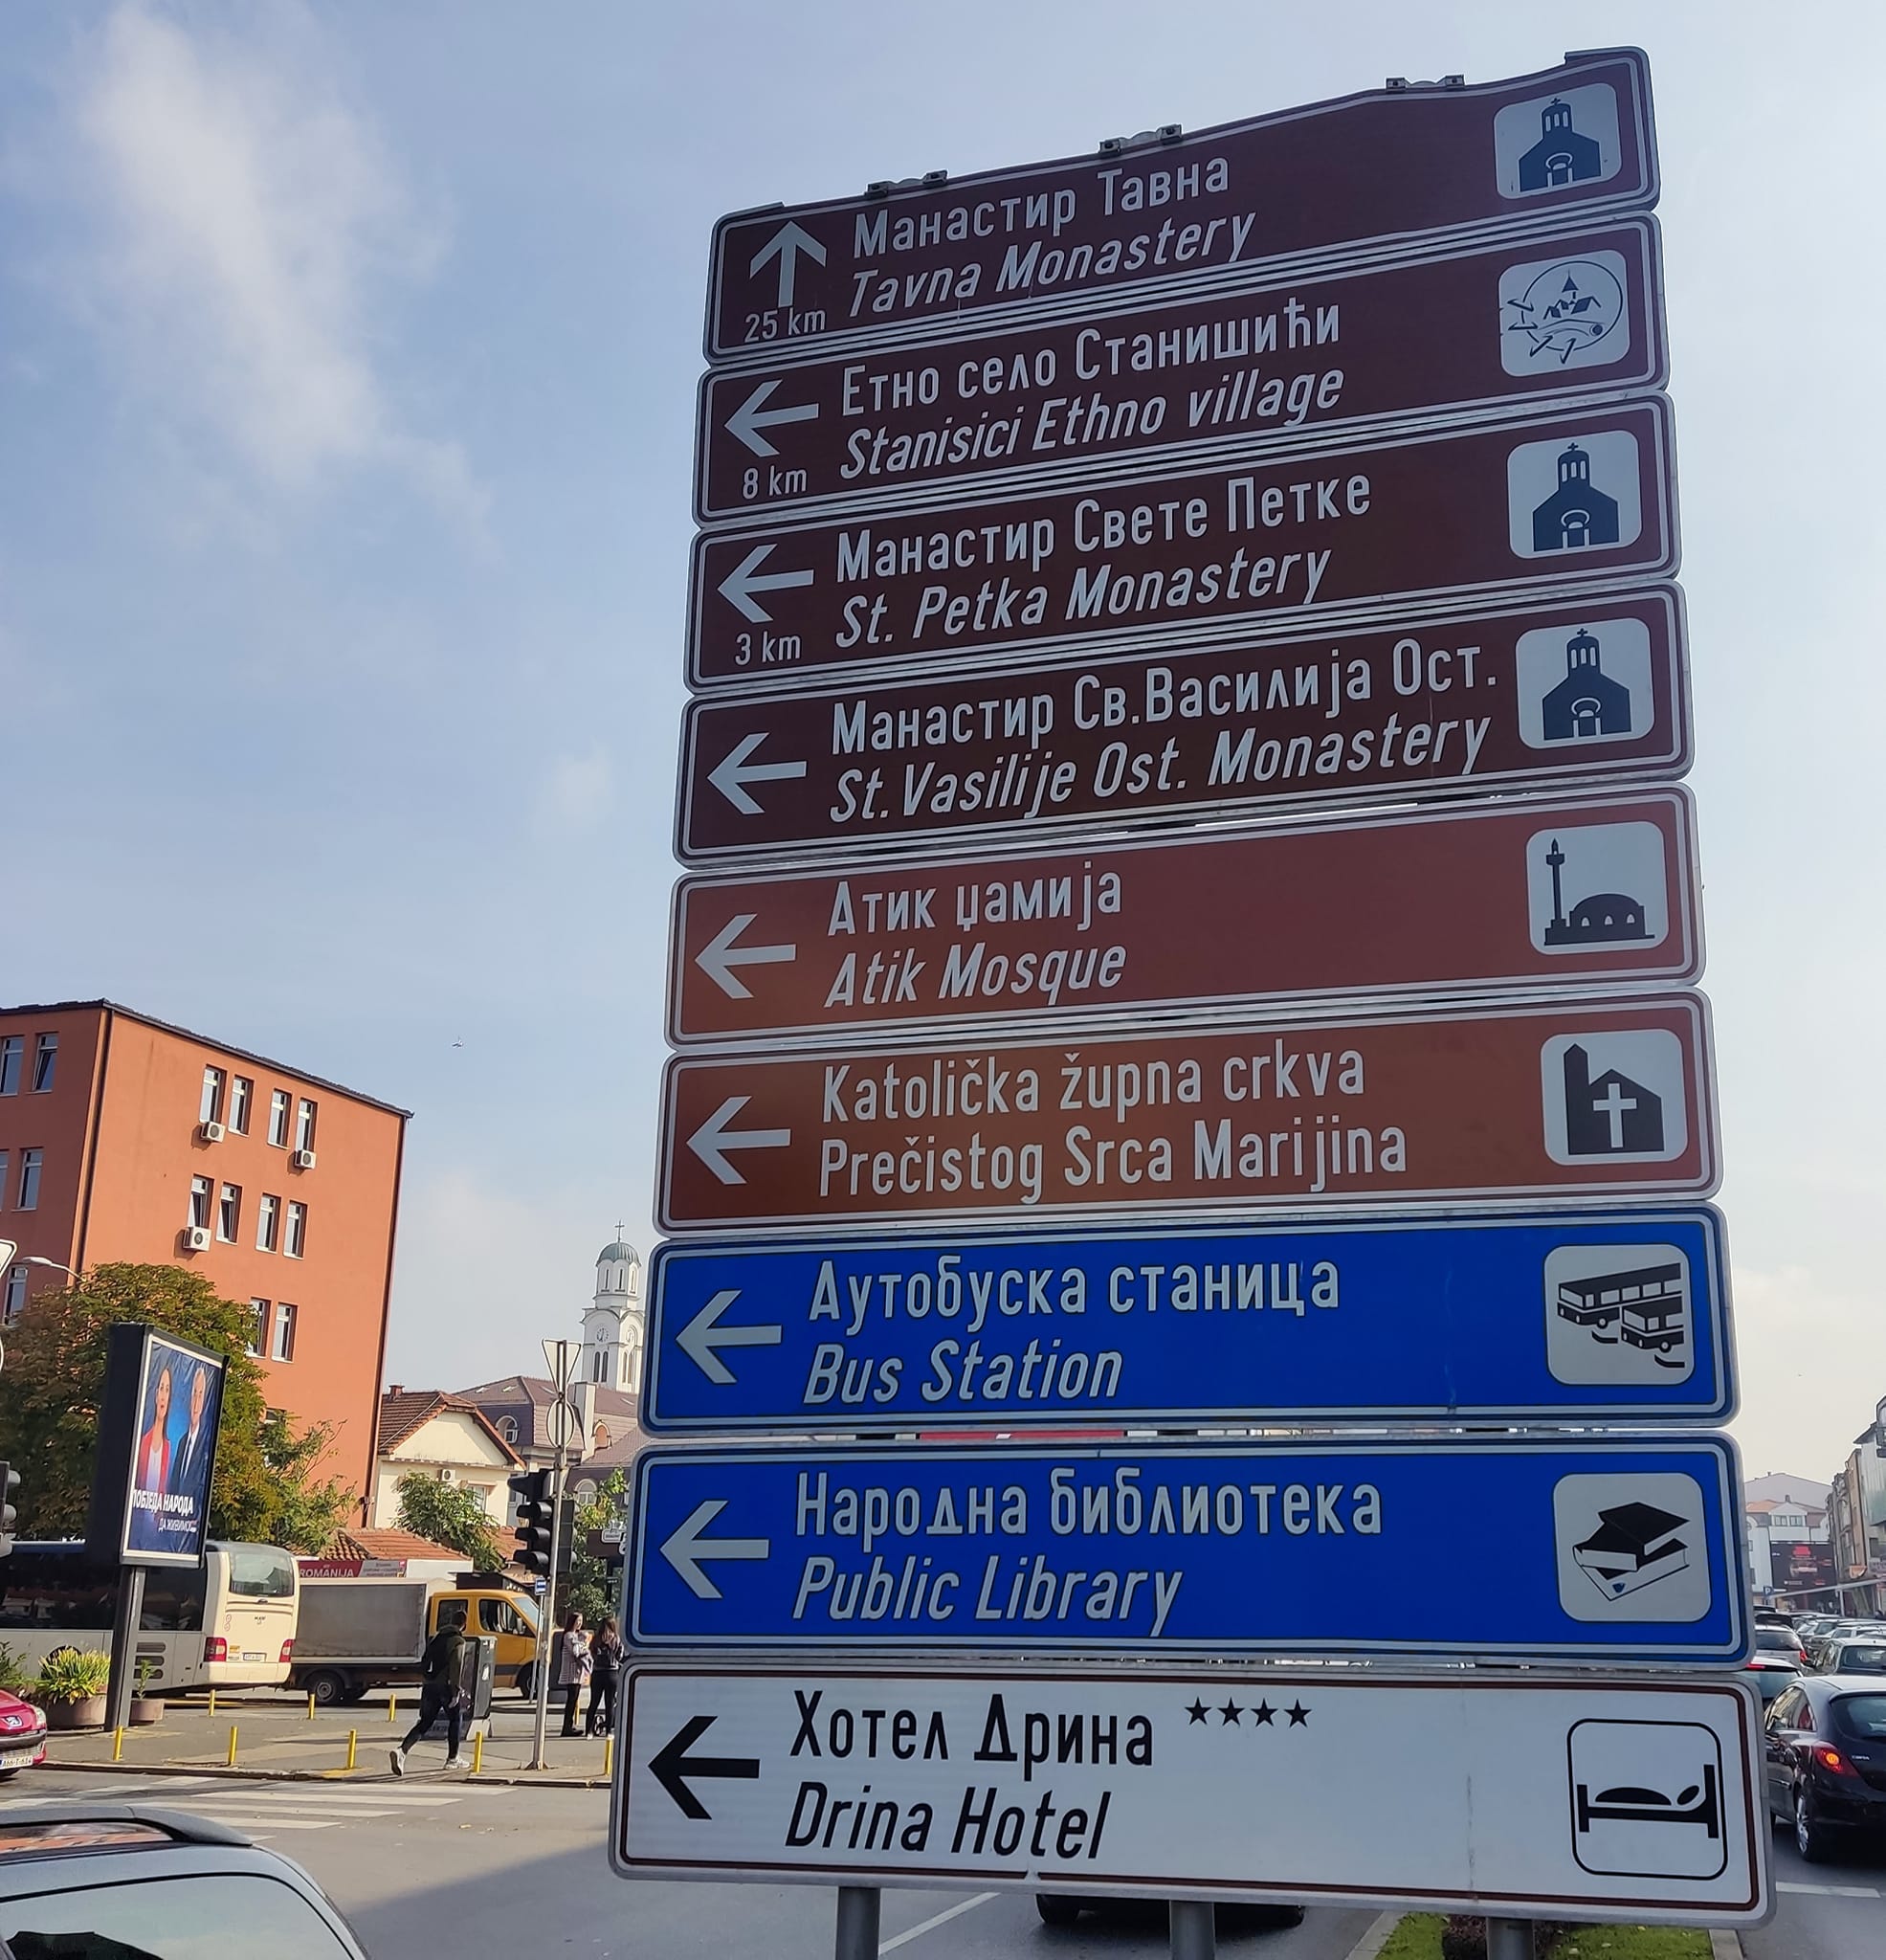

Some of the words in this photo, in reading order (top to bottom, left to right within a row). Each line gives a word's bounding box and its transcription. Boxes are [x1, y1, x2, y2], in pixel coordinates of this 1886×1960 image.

[854, 189, 1076, 258] Манастир
[1097, 157, 1229, 216] Тавна
[849, 263, 982, 318] Tavna
[995, 212, 1256, 293] Monastery
[743, 309, 778, 344] 25
[788, 307, 826, 336] km
[842, 365, 940, 416] Етно
[958, 348, 1056, 398] село
[1076, 297, 1339, 383] Станишићи
[840, 405, 1025, 479] Stanisici
[1032, 392, 1166, 451] Ethno
[1188, 368, 1344, 428] village
[743, 467, 759, 500] 8
[768, 465, 807, 497] km
[836, 519, 1054, 583] Манастир
[1075, 498, 1208, 552] Свете
[1228, 475, 1370, 532] Петке
[835, 592, 894, 648] St.
[912, 576, 1048, 639] Petka
[1064, 546, 1332, 621] Monastery
[735, 633, 751, 666] 3
[762, 631, 801, 663] km
[832, 694, 1054, 757] Манастир
[1074, 648, 1371, 730] Св.Василија
[1392, 638, 1497, 696] Ост.
[830, 768, 889, 823] St.
[903, 750, 1076, 819] Vasilije
[1093, 736, 1187, 797] Ost.
[1207, 712, 1492, 787] Monastery
[827, 880, 937, 937] Атик
[956, 860, 1121, 932] џамија
[823, 947, 926, 1008] Atik
[938, 942, 1126, 1006] Mosque
[823, 1056, 1039, 1123] Katolička
[1059, 1052, 1201, 1124] župna
[1223, 1037, 1365, 1102] crkva
[820, 1131, 1043, 1205] Prečistog
[1064, 1125, 1172, 1186] Srca
[1194, 1114, 1407, 1192] Marijina
[809, 1255, 1086, 1336] Аутобуска
[1109, 1261, 1339, 1317] станица
[803, 1344, 903, 1404] Bus
[921, 1338, 1122, 1401] Station
[163, 1493, 193, 1517] НАРОДА
[796, 1472, 1027, 1553] Народна
[1050, 1466, 1381, 1535] библиотека
[300, 1568, 354, 1578] ROMANIJA
[792, 1555, 960, 1620] Public
[975, 1554, 1183, 1637] Library
[789, 1689, 949, 1760] Хотел
[973, 1693, 1153, 1782] Дрина
[785, 1781, 933, 1852] Drina
[950, 1786, 1112, 1860] Hotel
